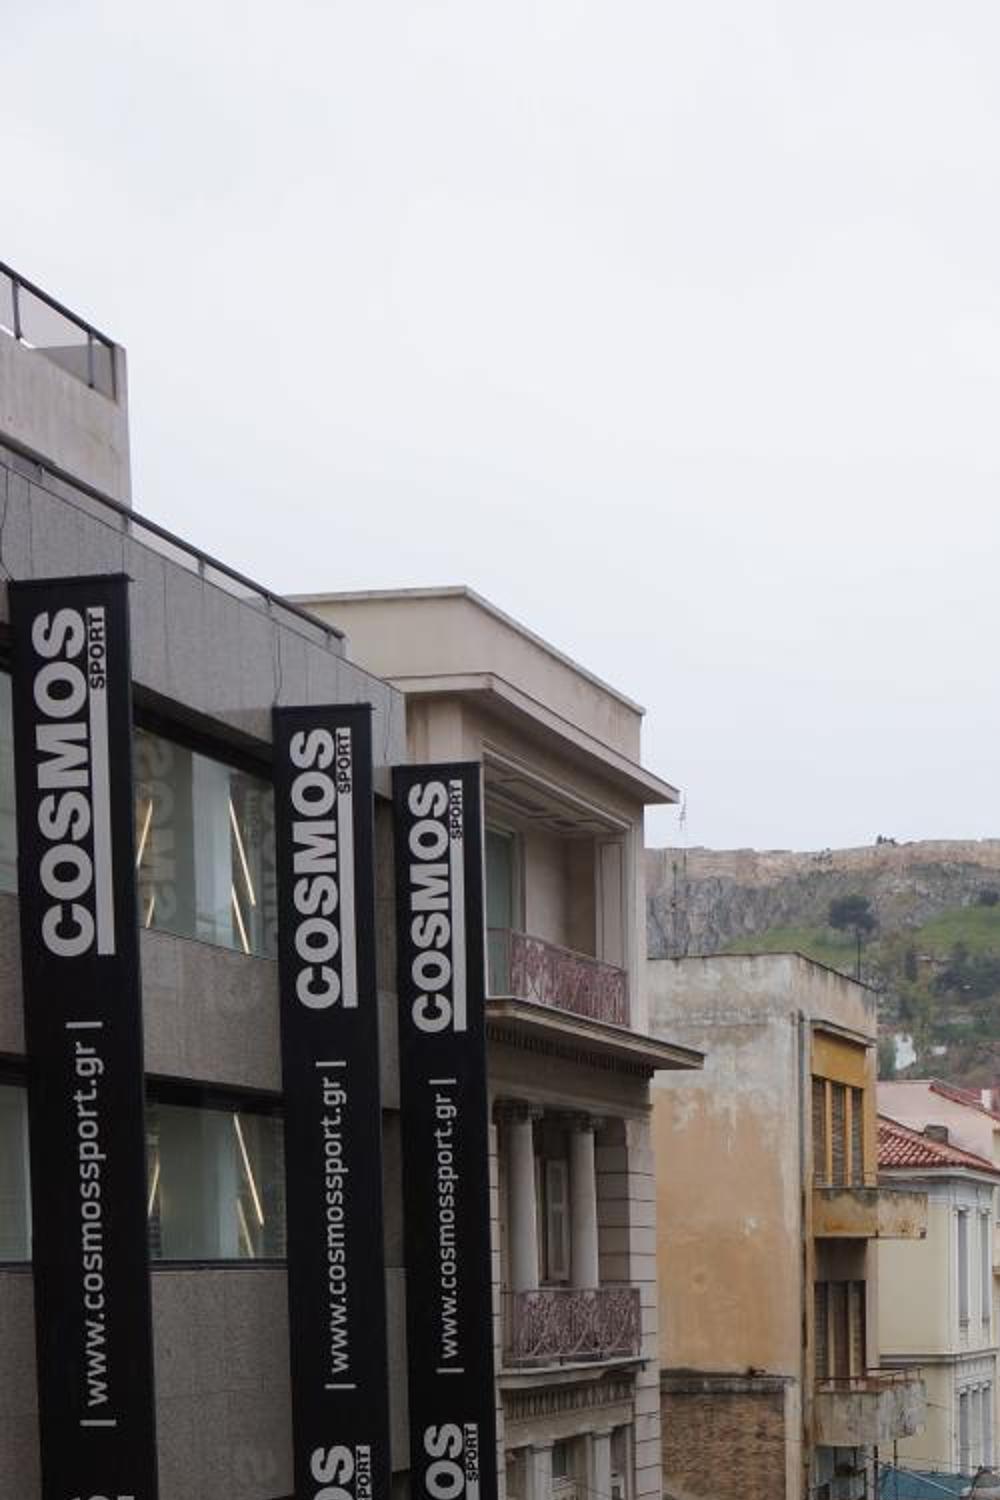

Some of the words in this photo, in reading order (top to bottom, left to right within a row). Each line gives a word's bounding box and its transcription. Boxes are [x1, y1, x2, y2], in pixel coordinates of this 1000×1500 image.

[88, 612, 106, 690] SPORT
[336, 734, 352, 795] SPORT
[31, 606, 96, 957] COSMOS
[289, 728, 341, 1009] COSMOS
[407, 781, 452, 1033] COSMOS
[449, 786, 463, 840] SPORT
[73, 1040, 107, 1407] www.cosmossport.gr
[321, 1076, 349, 1373] www.cosmossport.gr
[434, 1093, 459, 1358] www.cosmossport.gr
[465, 1428, 479, 1483] SPORT
